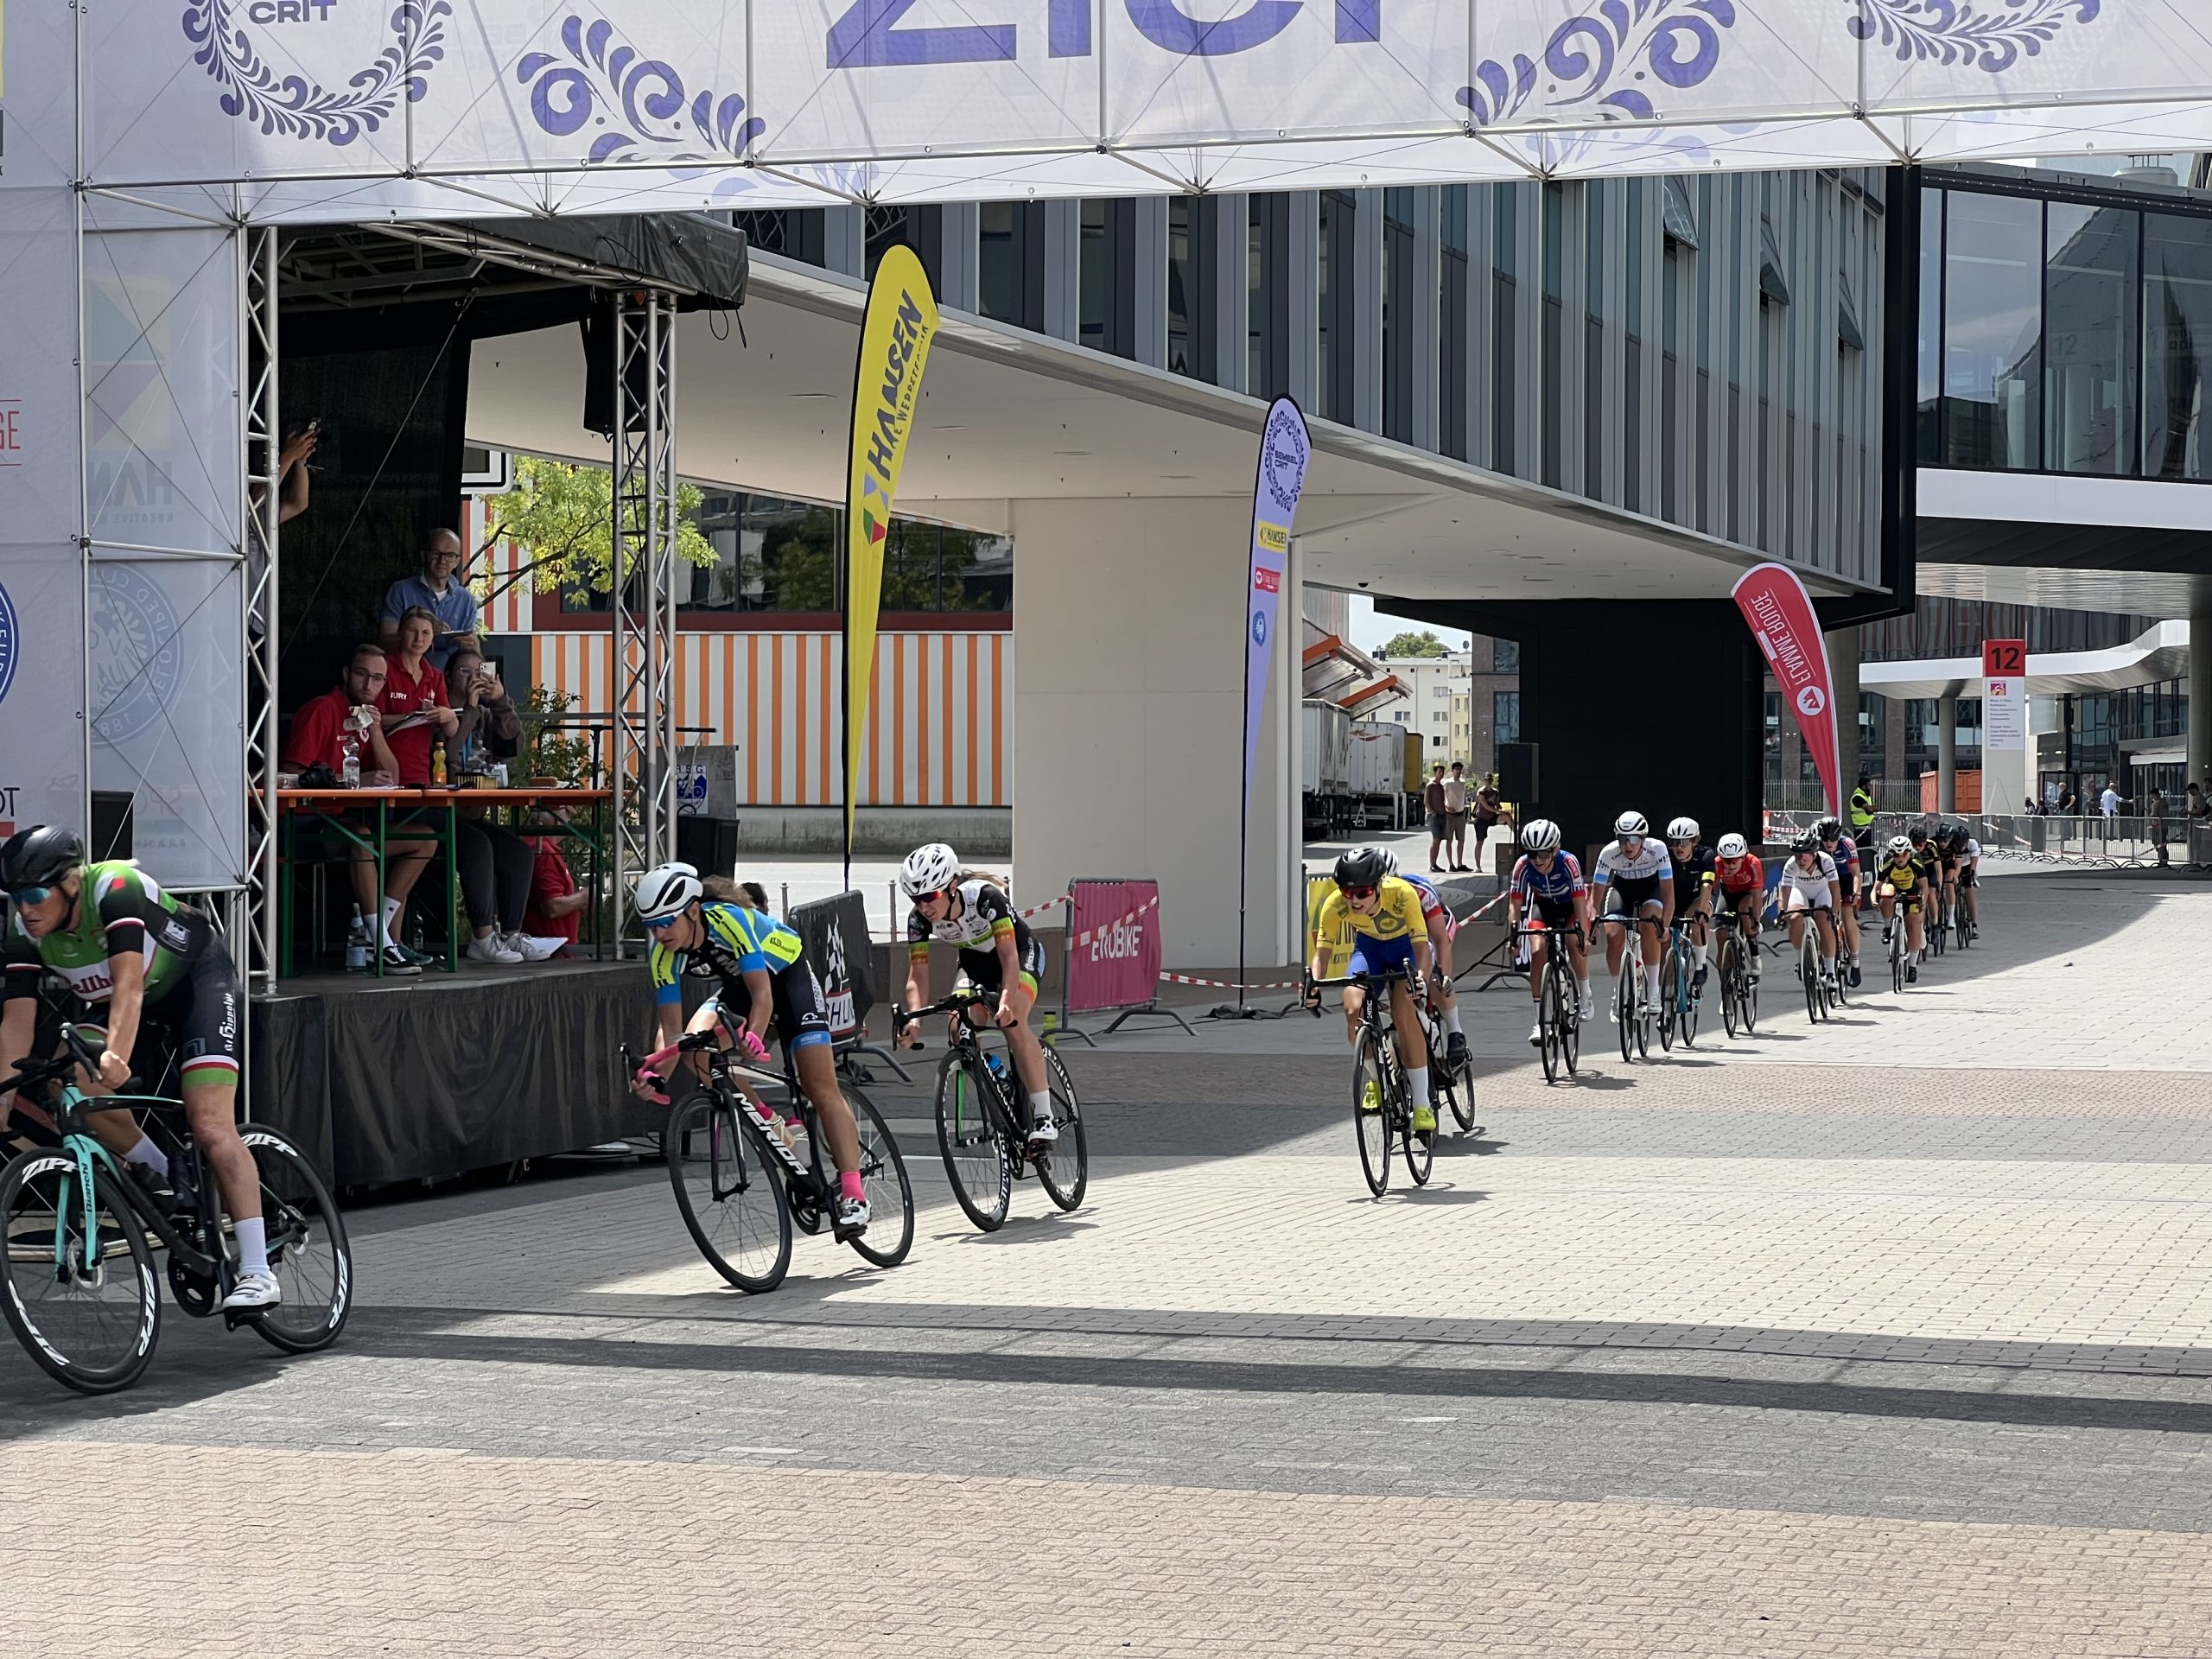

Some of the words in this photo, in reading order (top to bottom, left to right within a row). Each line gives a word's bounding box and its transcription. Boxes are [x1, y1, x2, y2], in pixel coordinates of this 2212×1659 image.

[249, 0, 337, 24] CRIT
[867, 288, 923, 481] HANSEN
[1274, 449, 1299, 465] BEMBEL
[1274, 460, 1288, 471] CRIT
[1267, 527, 1287, 544] HANSE
[1991, 646, 2020, 671] 12
[241, 1133, 299, 1158] ZIPP
[732, 1091, 810, 1176] MERIDA
[328, 1249, 347, 1330] ZIPP
[139, 1263, 157, 1357] ZIPP
